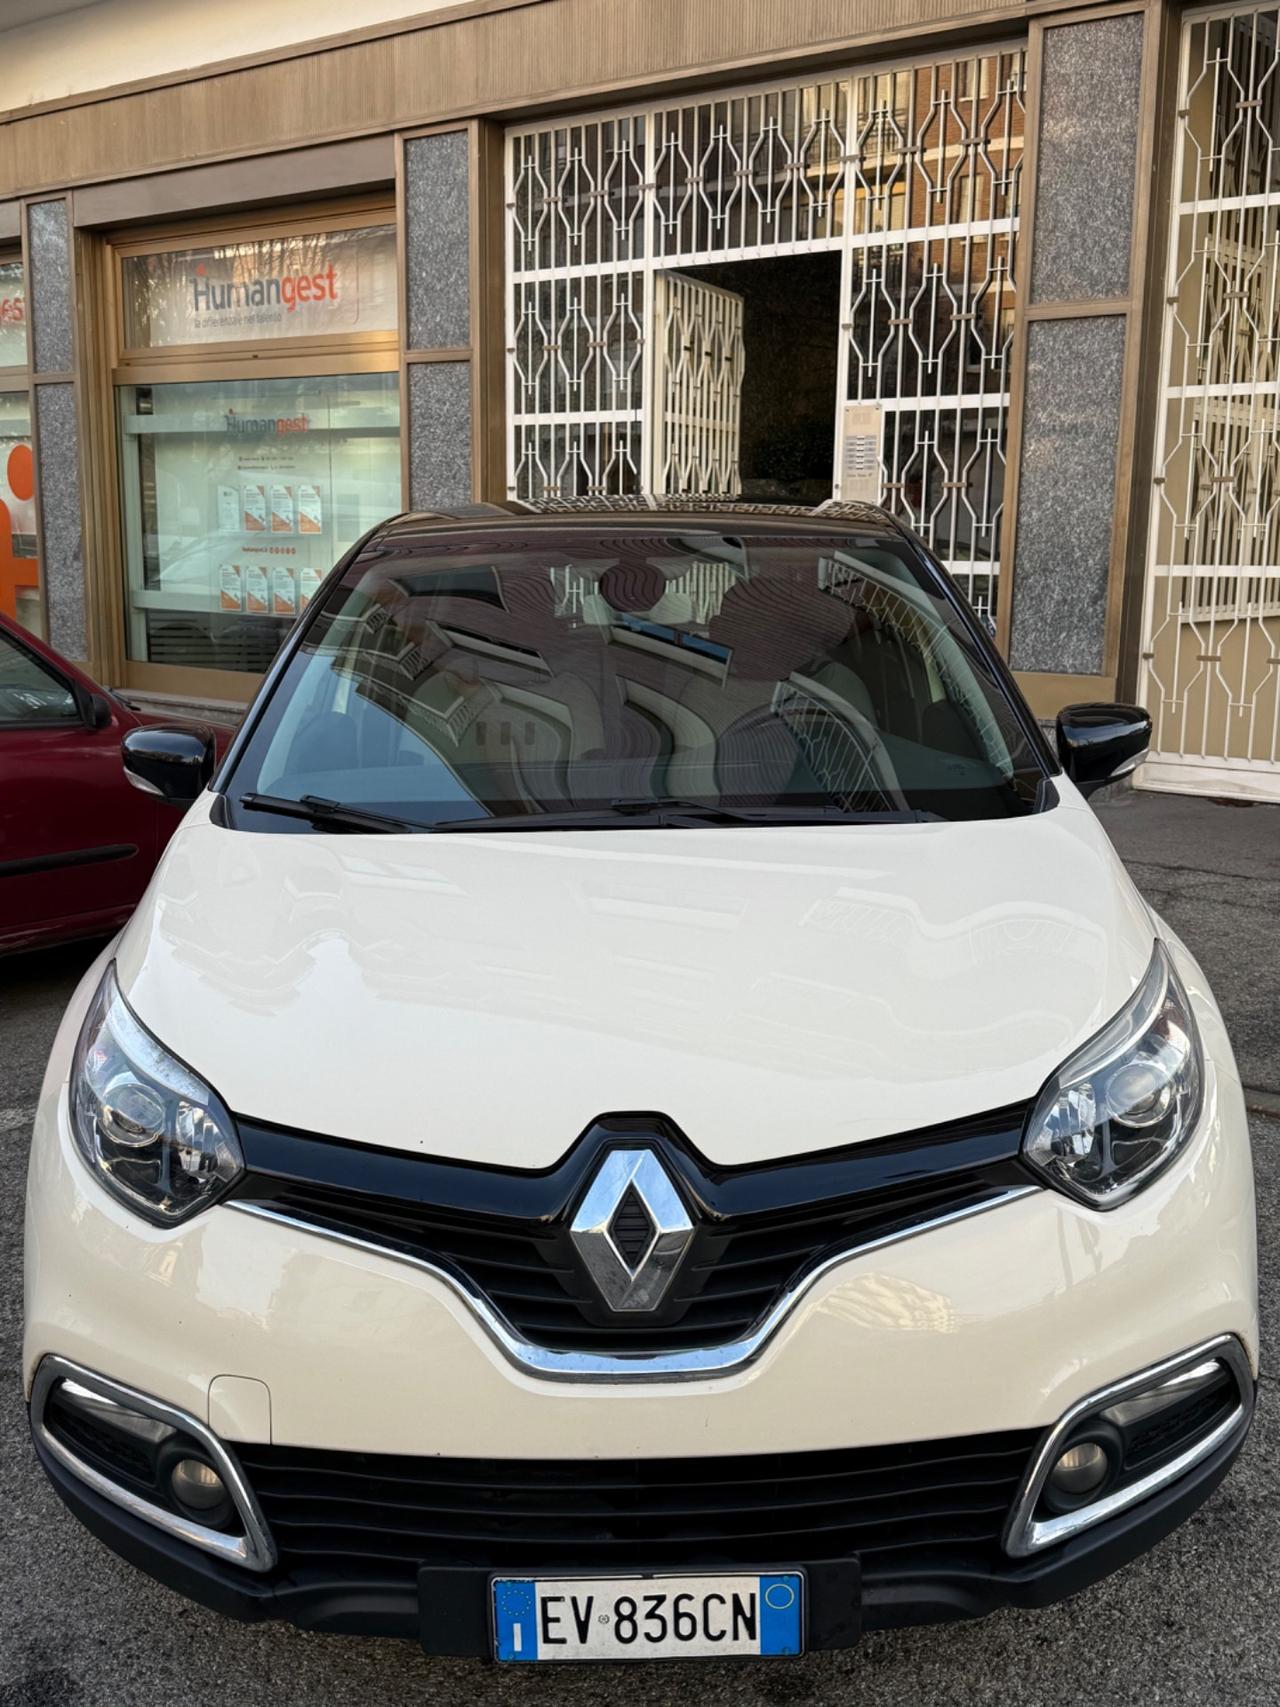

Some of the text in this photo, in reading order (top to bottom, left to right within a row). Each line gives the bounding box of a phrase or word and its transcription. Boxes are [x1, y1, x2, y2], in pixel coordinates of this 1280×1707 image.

[189, 262, 338, 313] Humangest
[224, 410, 309, 438] Humangest
[512, 1622, 523, 1652] I
[540, 1592, 757, 1645] EV 836CN
